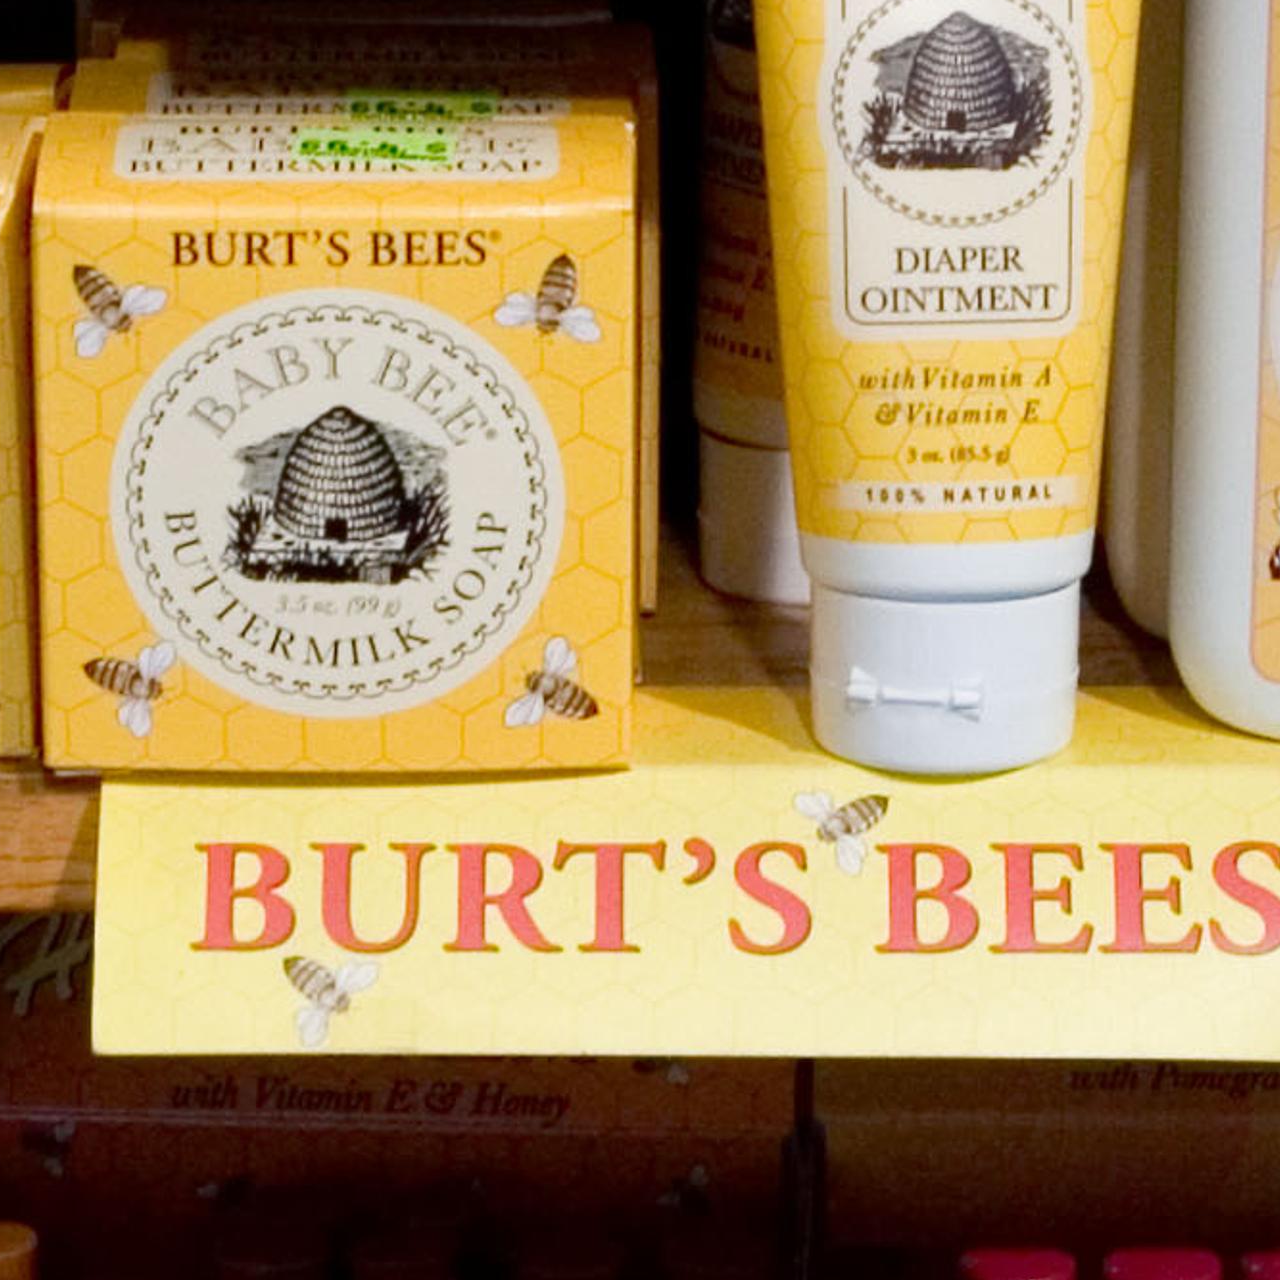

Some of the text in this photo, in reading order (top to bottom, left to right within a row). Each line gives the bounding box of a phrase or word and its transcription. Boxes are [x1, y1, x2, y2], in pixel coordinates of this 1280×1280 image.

[172, 230, 490, 267] BURT'S BEES
[895, 246, 1023, 274] DIAPER
[861, 285, 1057, 313] OINTMENT
[859, 365, 1052, 390] with Vitamin A
[187, 337, 488, 447] BABY BEE
[875, 400, 1041, 424] & Vitamin E
[866, 485, 1052, 503] 100% NATURAL
[163, 509, 510, 668] BUTTERMILK SOAP
[189, 839, 812, 955] BURT'S
